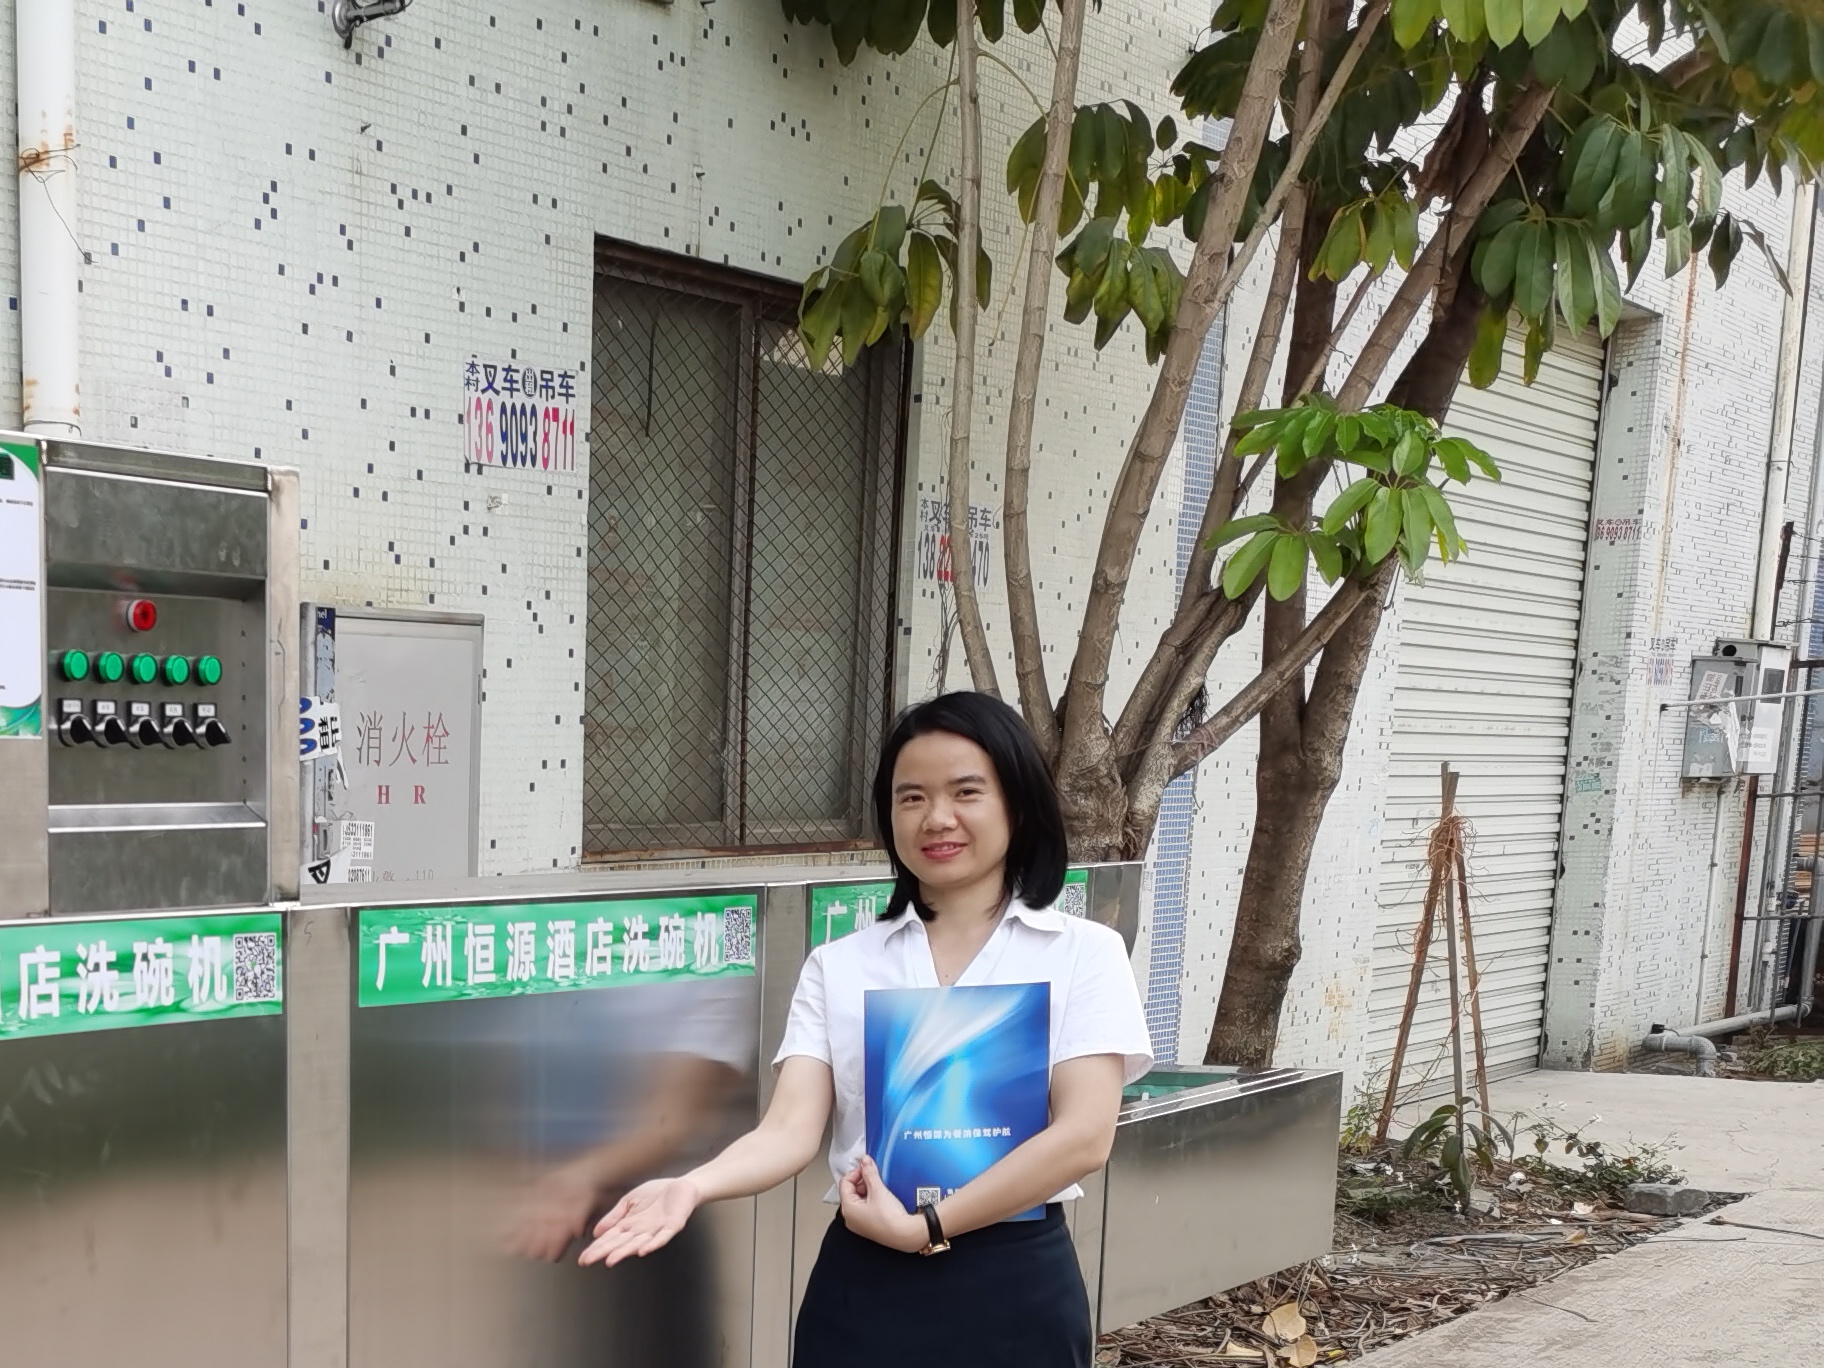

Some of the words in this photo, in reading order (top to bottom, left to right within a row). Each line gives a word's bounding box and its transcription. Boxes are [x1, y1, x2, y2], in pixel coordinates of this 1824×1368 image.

[466, 396, 494, 464] 136
[500, 401, 538, 468] 9093
[542, 406, 575, 471] 8711
[917, 531, 936, 581] 138
[356, 710, 450, 767] 消火栓
[377, 785, 390, 805] H
[414, 785, 426, 805] R
[374, 911, 721, 992] 广州恒源酒店洗碗机
